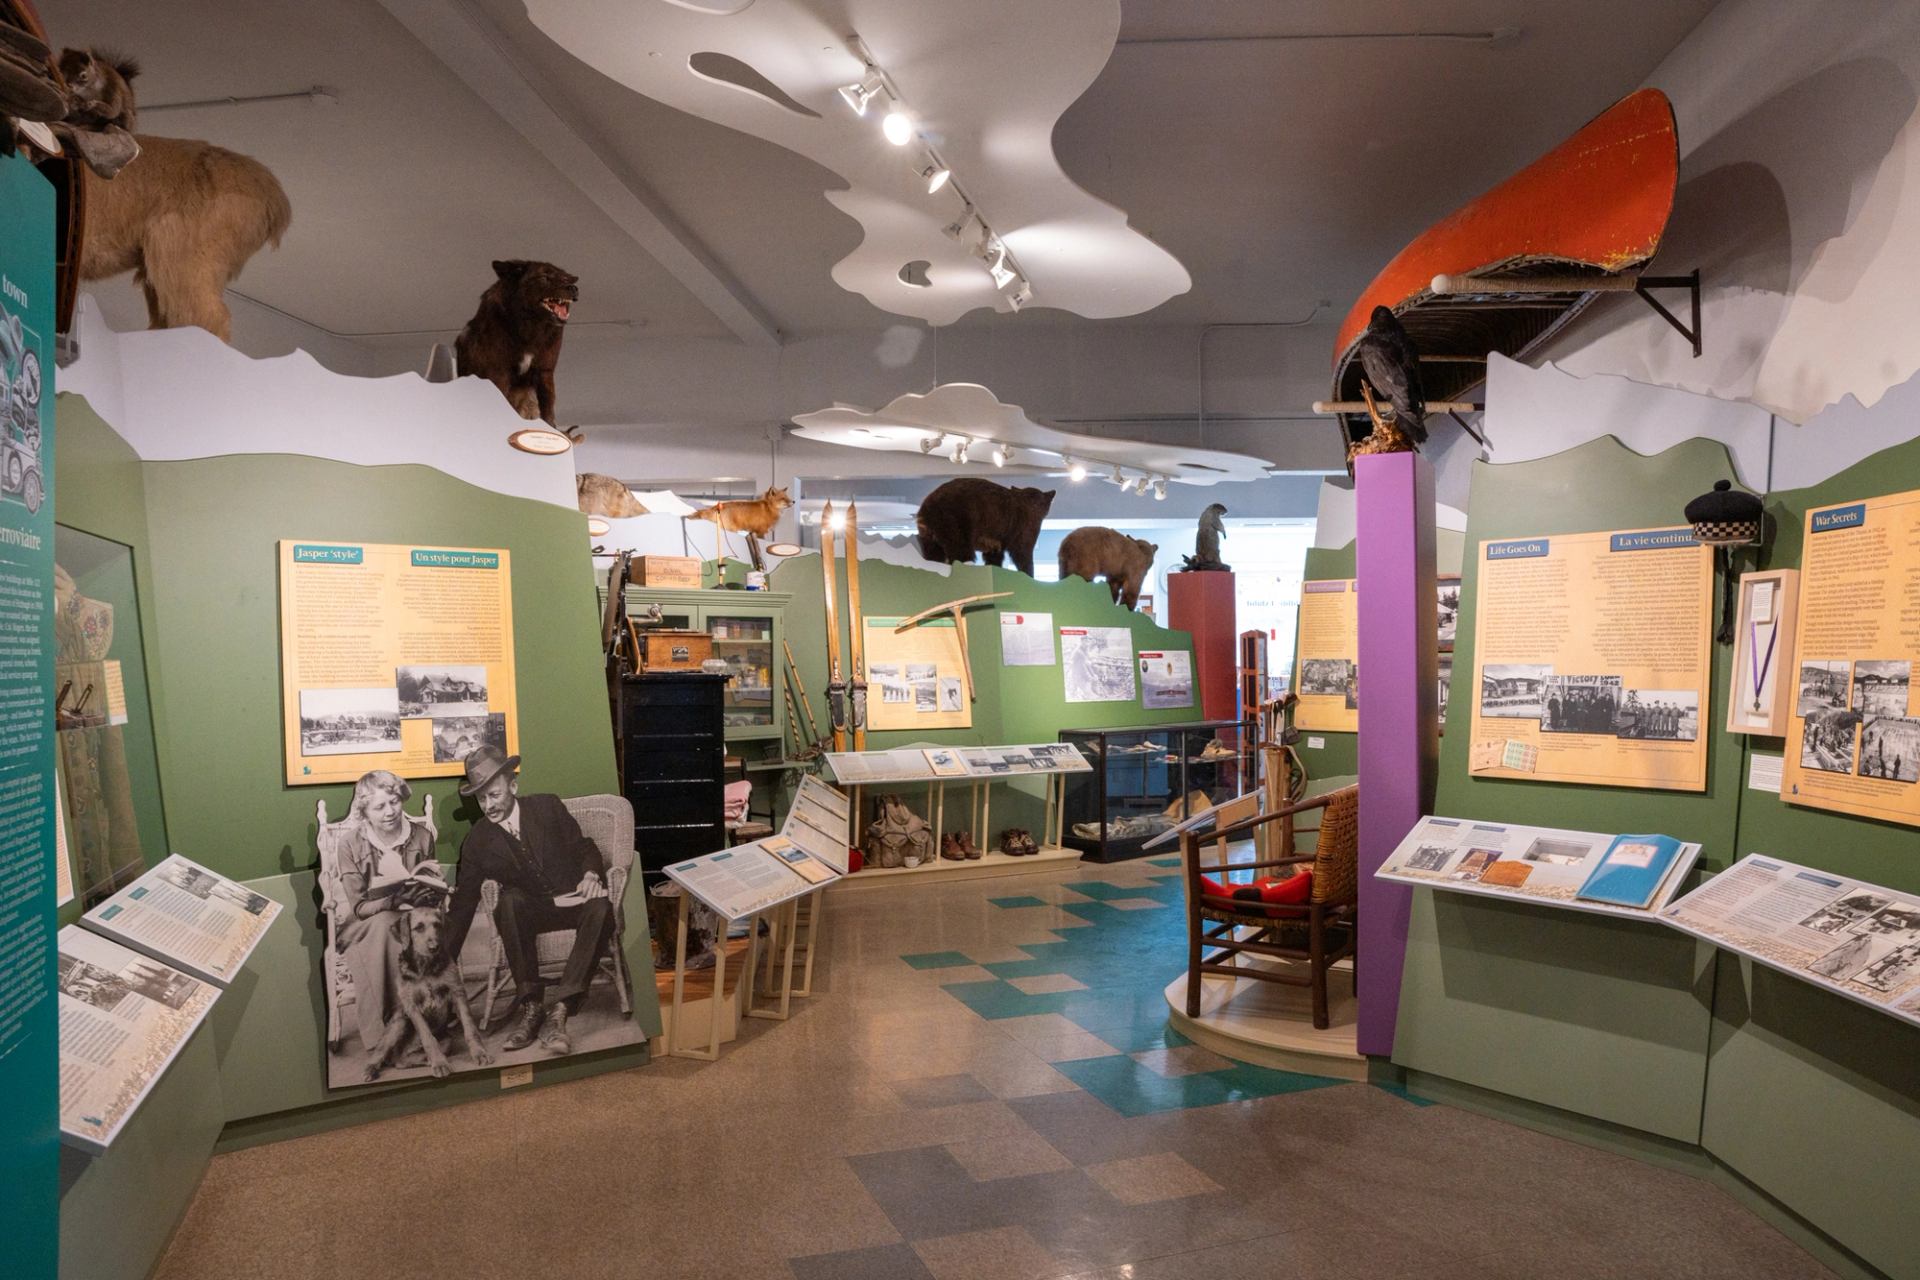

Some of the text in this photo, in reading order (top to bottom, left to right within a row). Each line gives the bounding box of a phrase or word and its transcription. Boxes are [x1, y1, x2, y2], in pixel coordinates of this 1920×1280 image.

[2, 273, 28, 309] town
[1816, 512, 1857, 526] War Secrets
[1619, 533, 1693, 546] La vie continu
[297, 548, 329, 560] Jasper
[1490, 544, 1541, 554] Life Goes On
[415, 553, 497, 566] Un style pour Jasper
